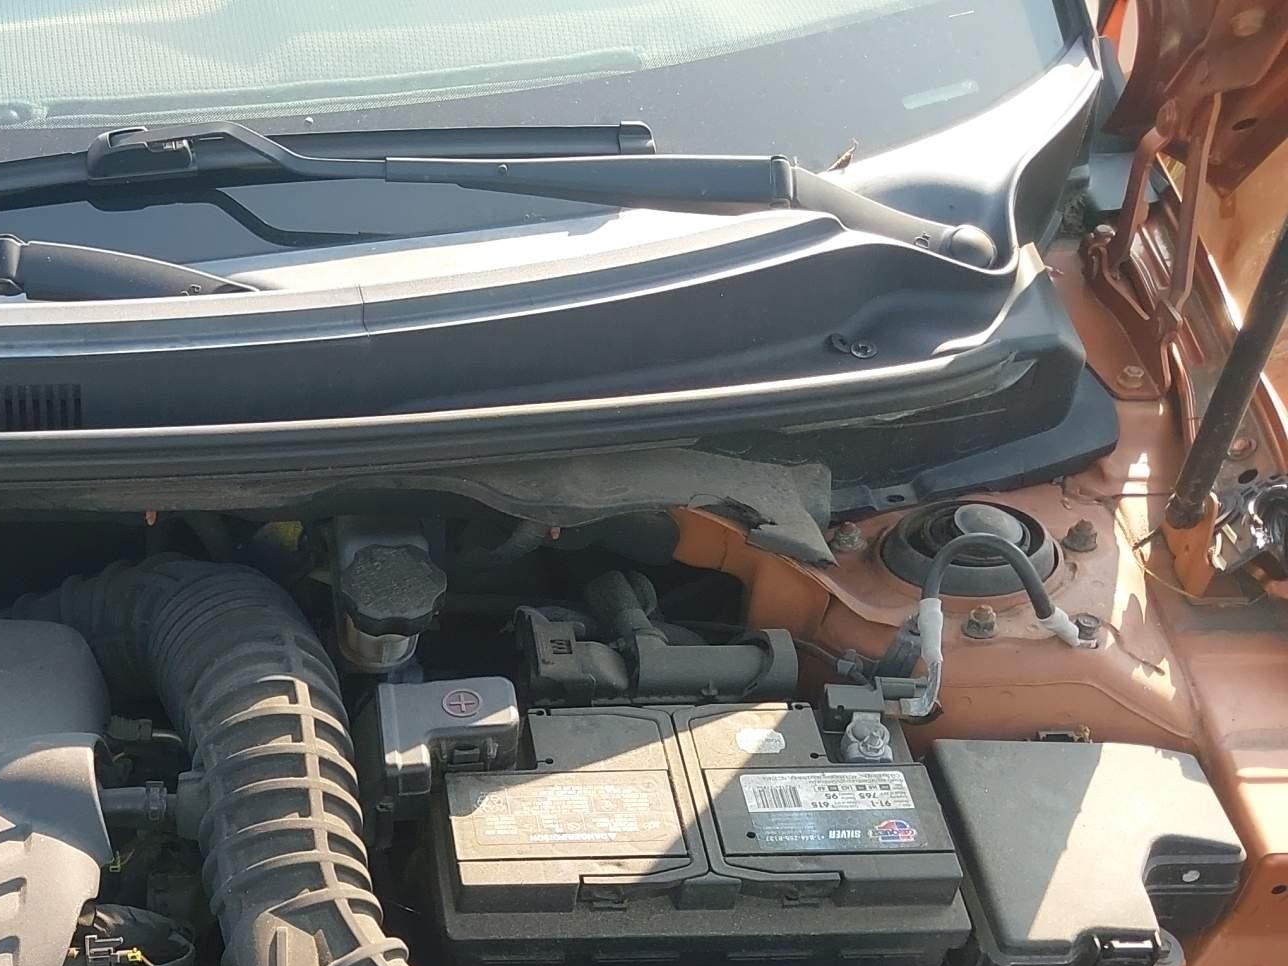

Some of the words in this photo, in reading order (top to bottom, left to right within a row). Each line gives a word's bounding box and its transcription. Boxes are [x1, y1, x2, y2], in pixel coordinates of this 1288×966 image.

[824, 792, 839, 800] 95
[858, 792, 879, 800] 765
[811, 800, 830, 809] 615
[871, 799, 892, 807] 91-1
[828, 829, 862, 839] SILVER
